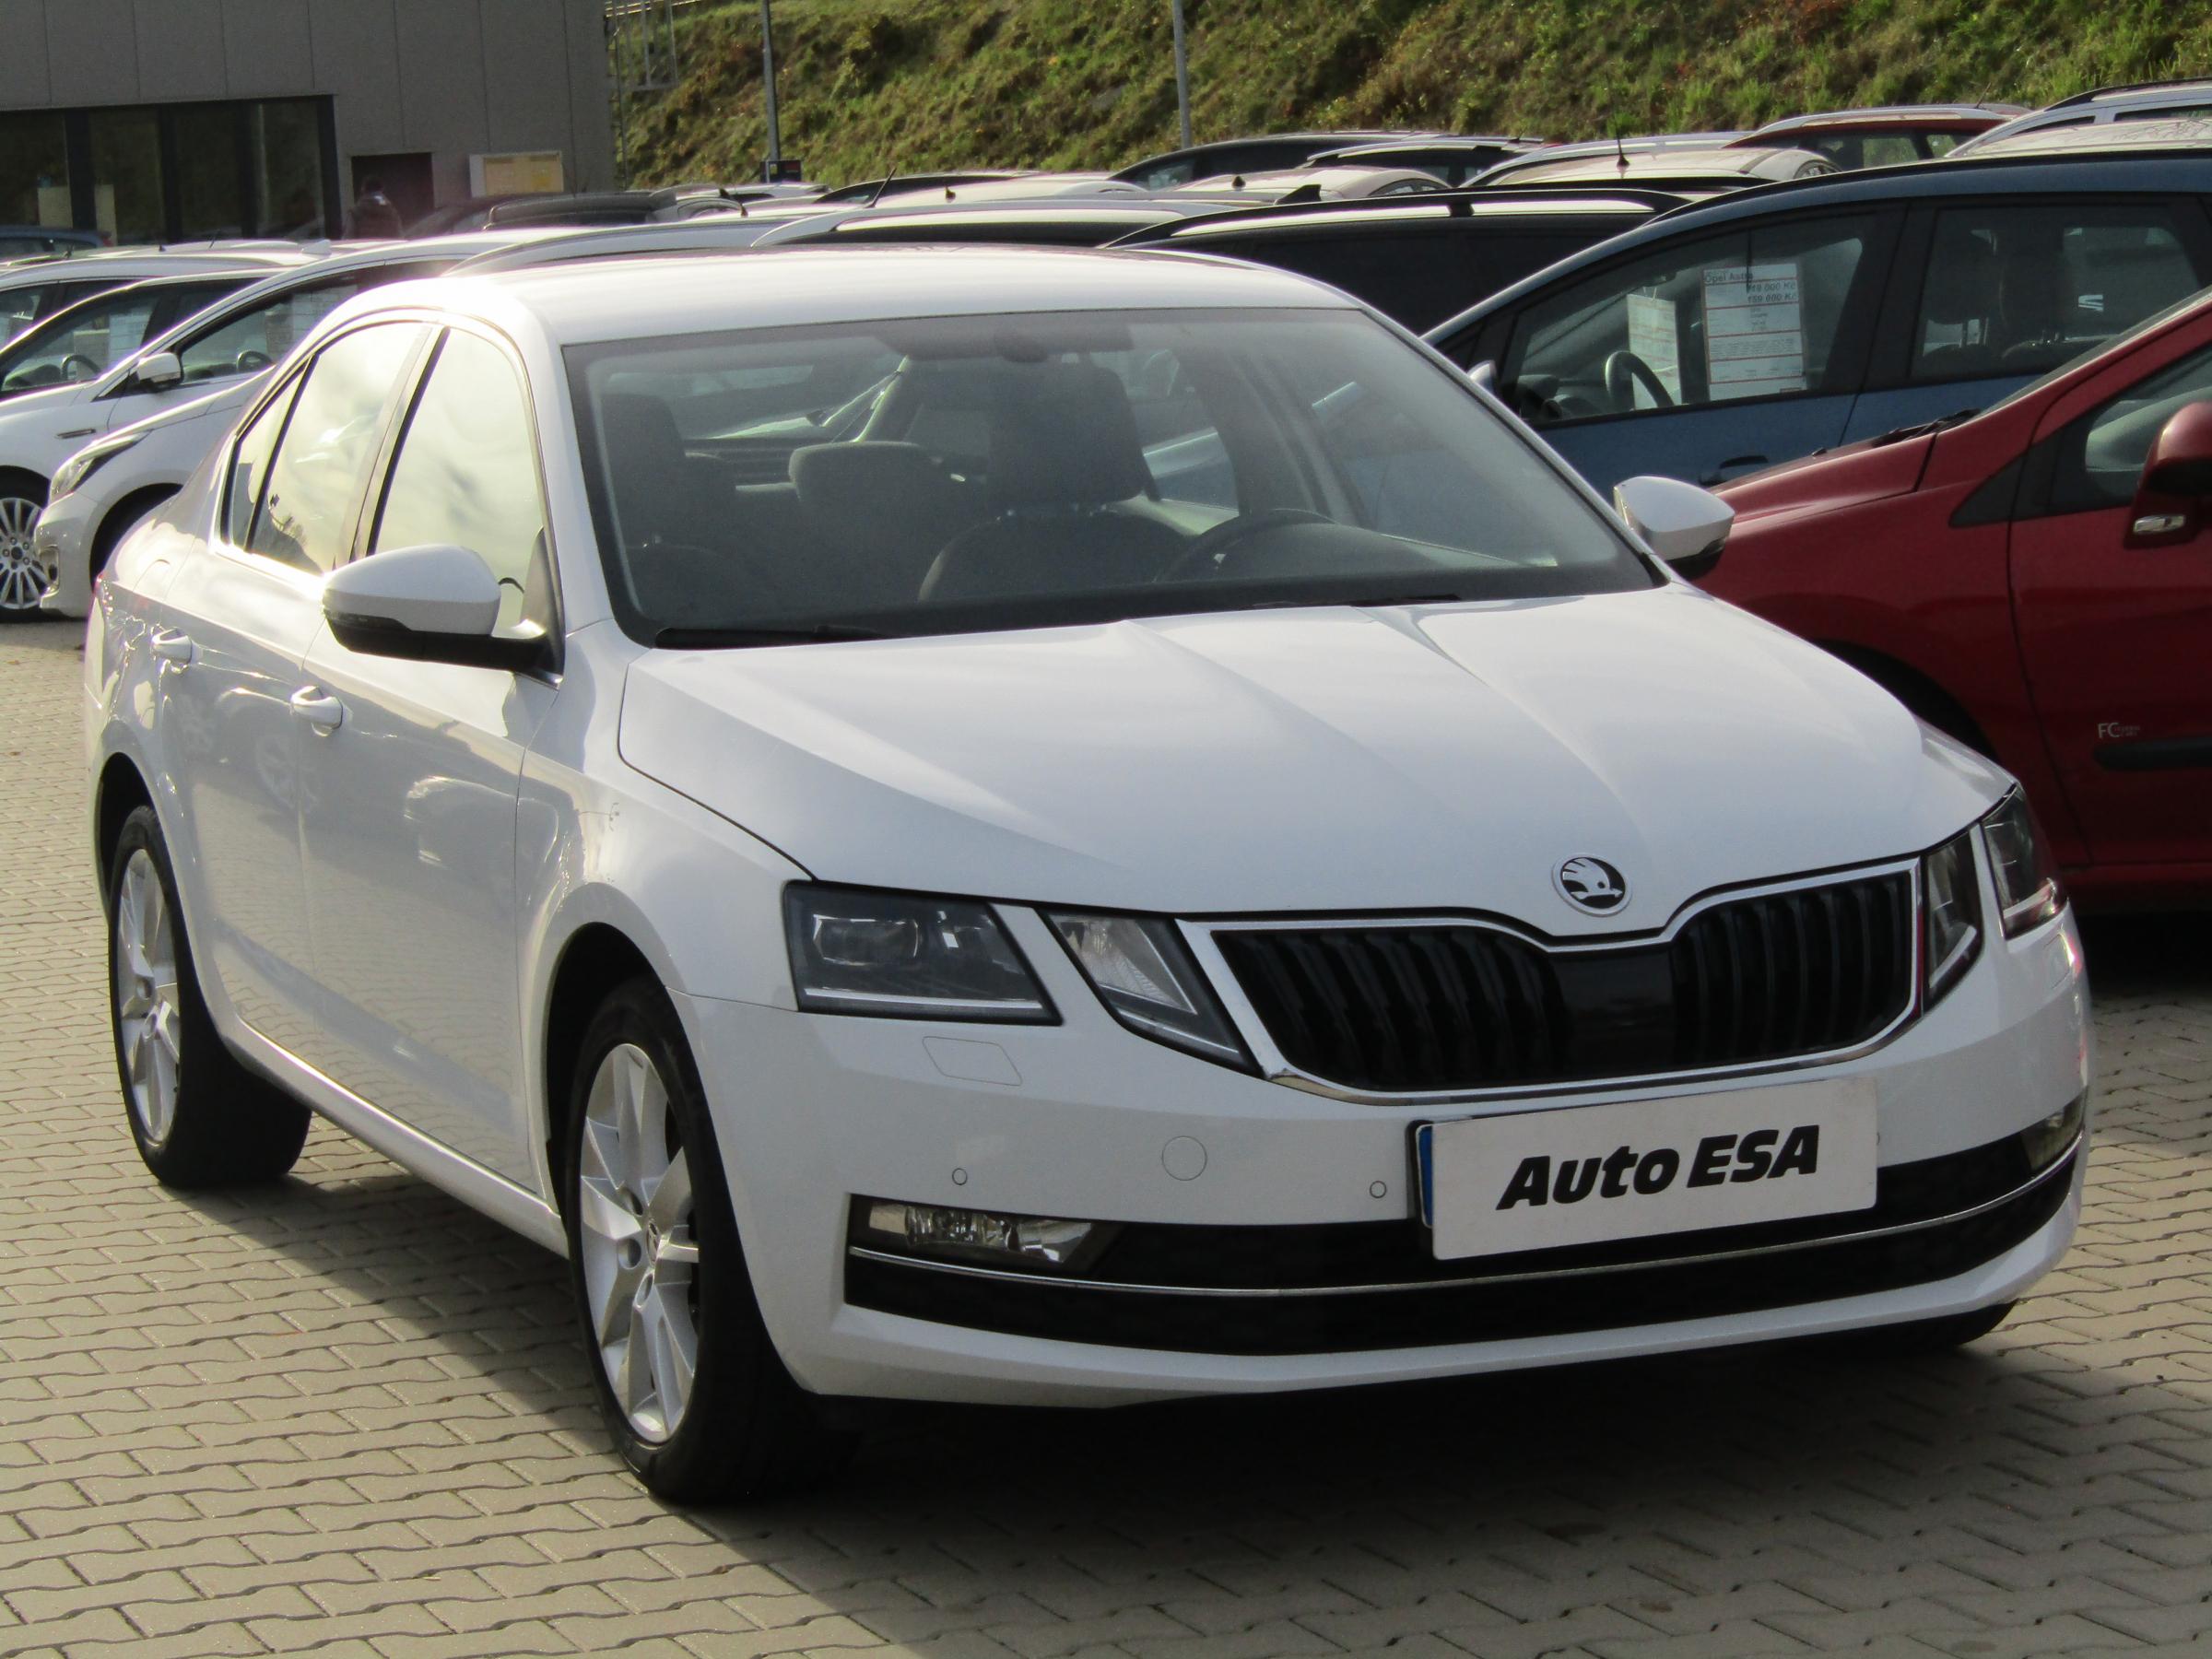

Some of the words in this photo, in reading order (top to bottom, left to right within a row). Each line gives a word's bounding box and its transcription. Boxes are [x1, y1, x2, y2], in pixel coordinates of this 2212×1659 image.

[1704, 272, 1726, 284] Opel
[1766, 293, 1782, 302] 000
[1496, 1146, 1680, 1210] Auto
[1688, 1124, 1819, 1188] ESA
